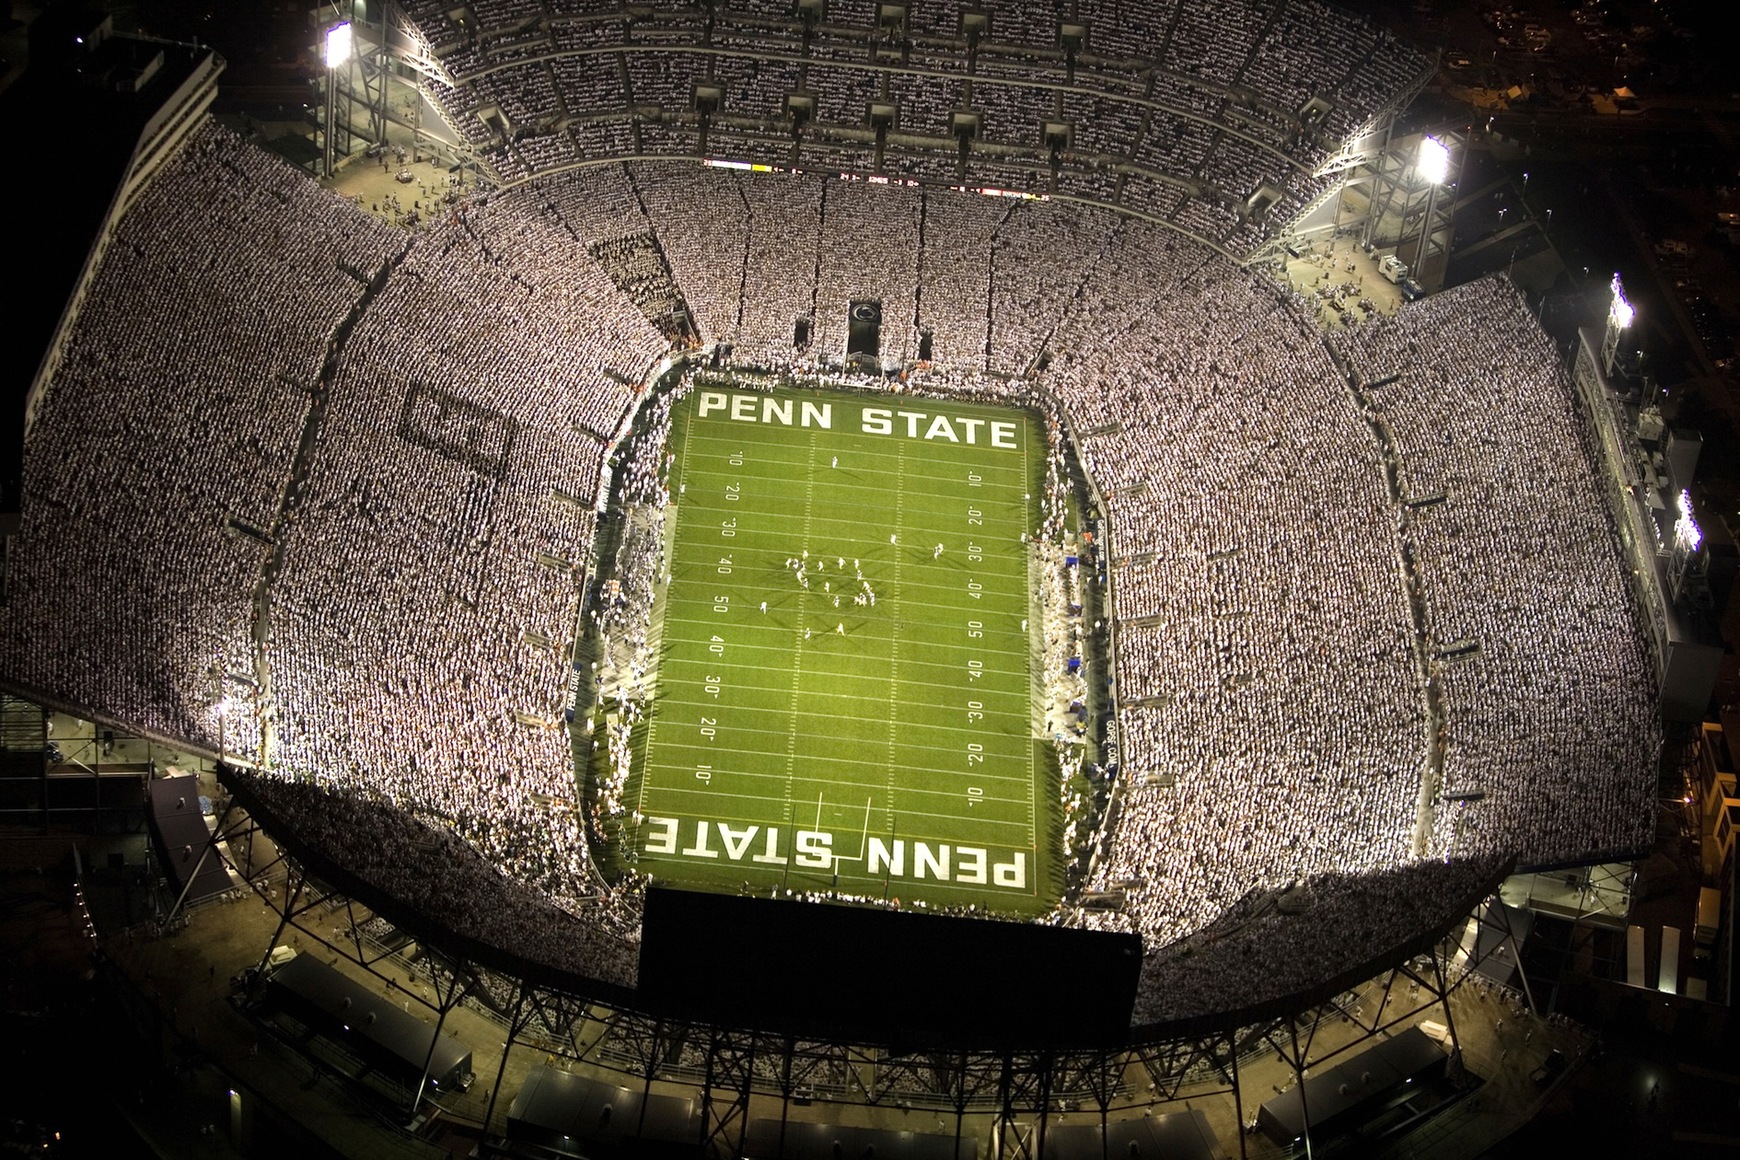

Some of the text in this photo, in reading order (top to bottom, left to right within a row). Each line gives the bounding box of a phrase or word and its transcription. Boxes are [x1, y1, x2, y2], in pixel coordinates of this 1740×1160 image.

[699, 392, 1017, 449] PENN STATE
[730, 452, 742, 466] 10
[968, 474, 982, 487] 10
[726, 483, 740, 501] 20
[968, 509, 982, 526] 20
[722, 519, 736, 537] 30
[968, 545, 982, 562] 30
[718, 557, 732, 574] 40
[968, 582, 982, 600] 40
[714, 595, 728, 613] 50
[968, 620, 982, 639] 50
[709, 635, 724, 652] 40
[968, 660, 983, 678] 40
[566, 669, 581, 711] PENN STATE
[705, 675, 720, 694] 30
[968, 700, 983, 720] 30
[701, 717, 716, 736] 20
[968, 743, 983, 763] 20
[695, 765, 711, 780] 10
[968, 787, 983, 803] 10
[644, 815, 1026, 889] PENN STATE
